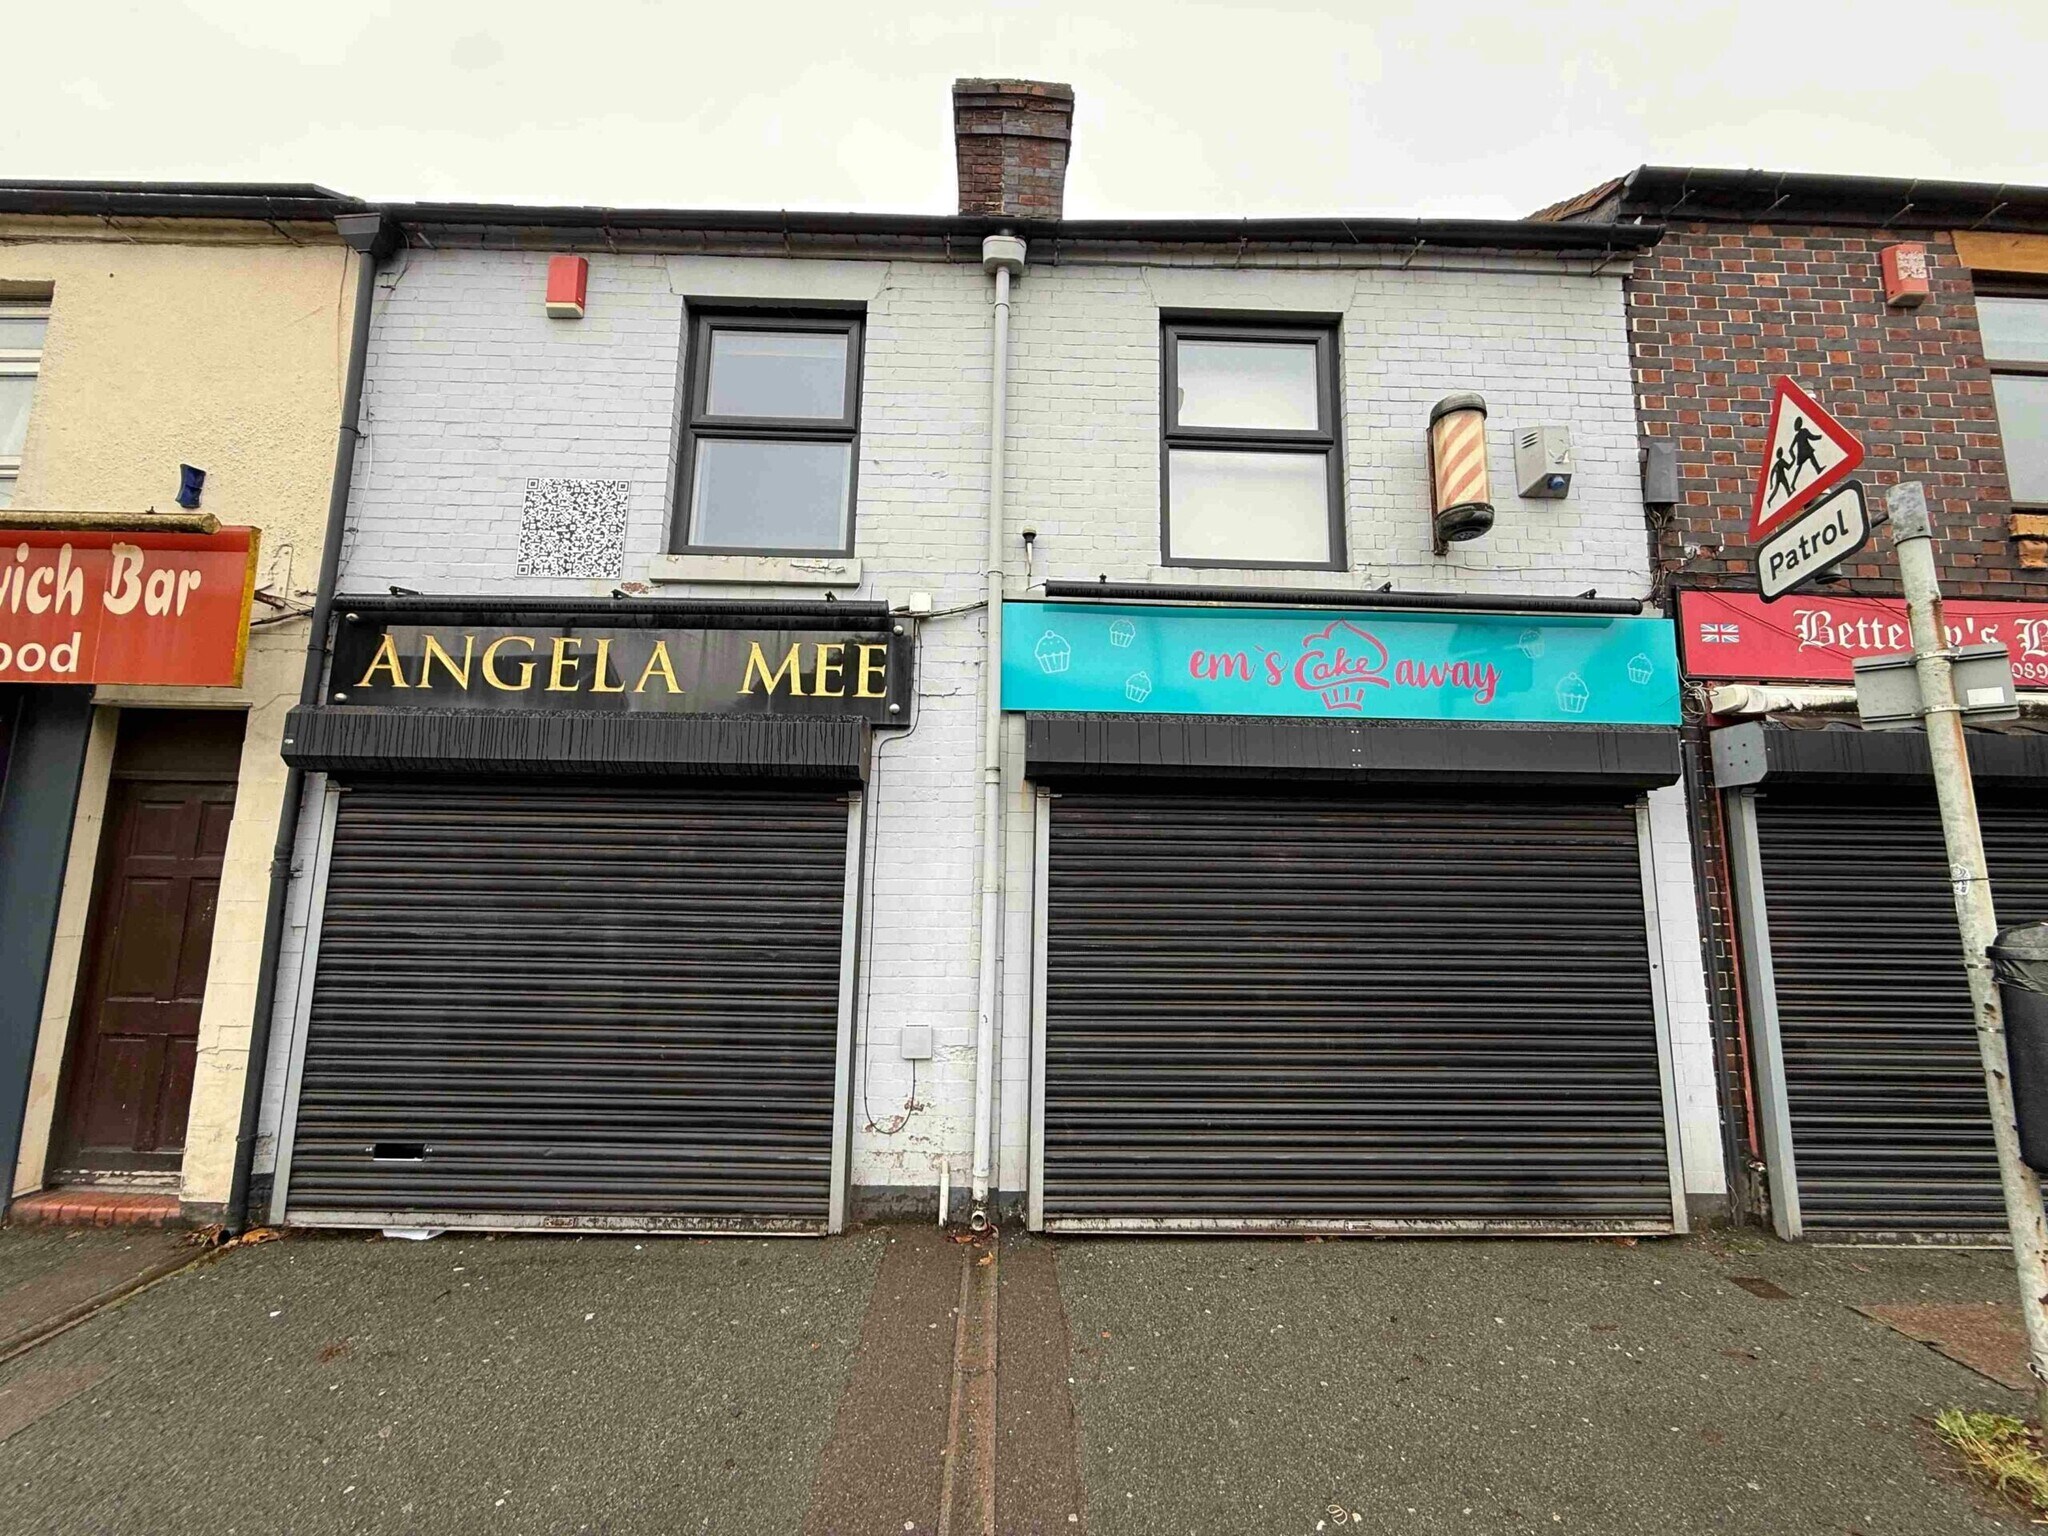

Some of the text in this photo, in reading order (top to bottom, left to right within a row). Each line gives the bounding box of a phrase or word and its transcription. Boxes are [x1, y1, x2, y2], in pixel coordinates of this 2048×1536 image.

[103, 541, 202, 617] Bar
[1769, 509, 1849, 581] Patrol
[354, 632, 888, 699] ANGELA MEE
[1294, 647, 1390, 691] Cake
[1395, 658, 1503, 704] away
